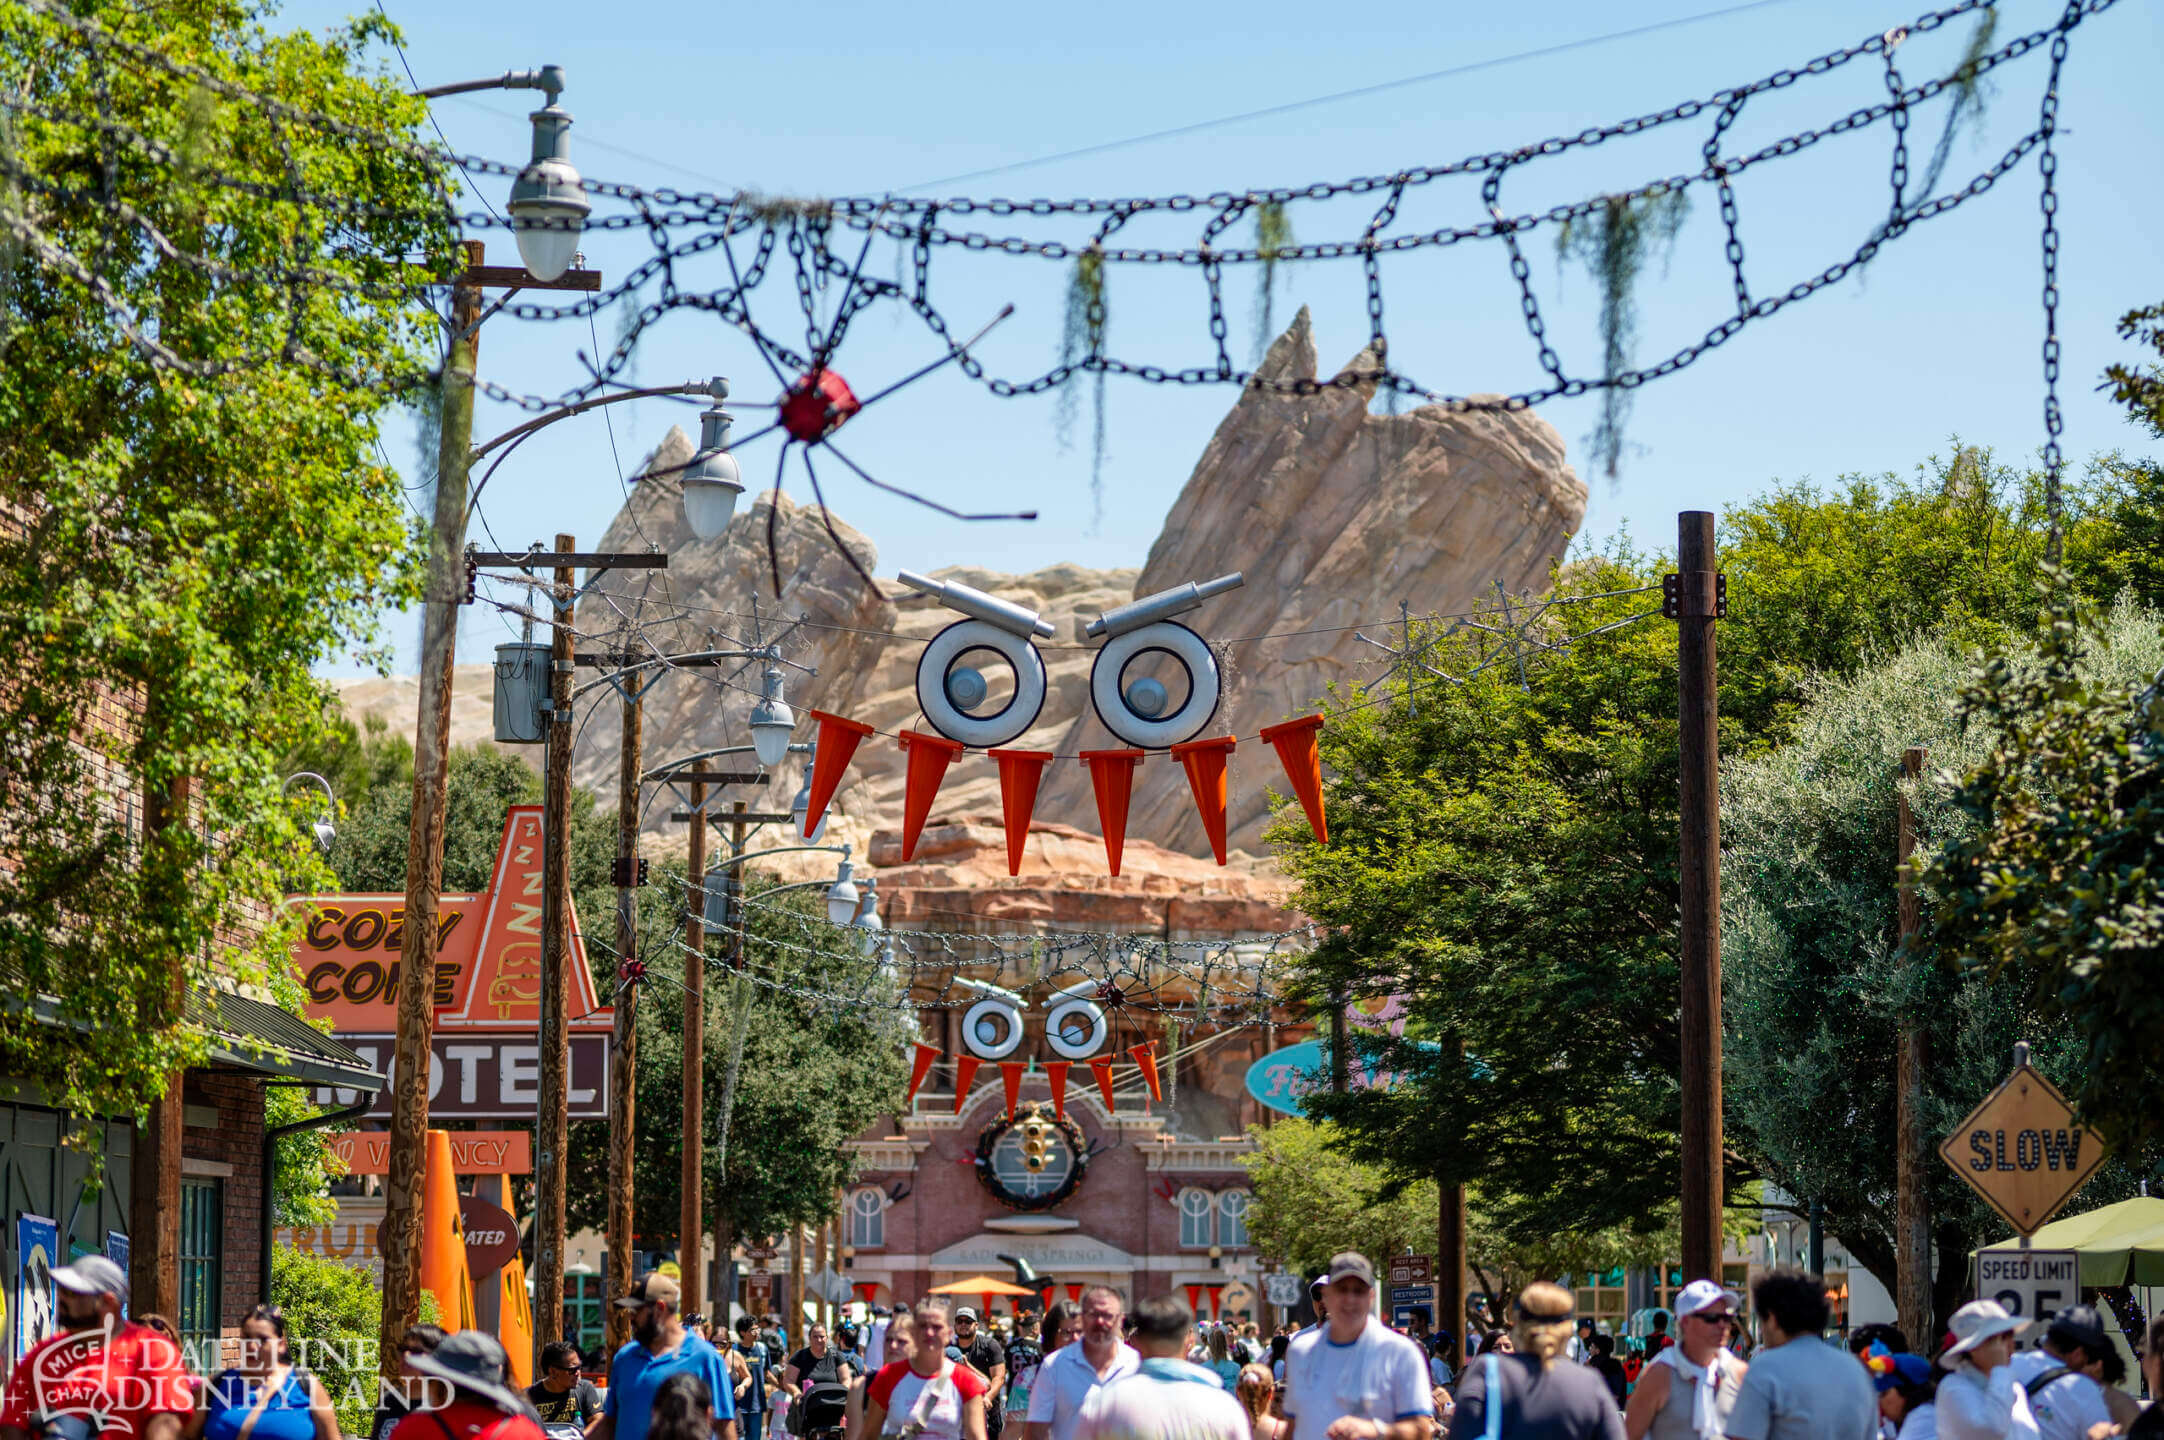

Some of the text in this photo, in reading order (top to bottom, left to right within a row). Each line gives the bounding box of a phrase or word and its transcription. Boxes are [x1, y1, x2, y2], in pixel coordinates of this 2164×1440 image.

[367, 1140, 510, 1167] VNCY
[1969, 1129, 2082, 1172] SLOW
[1982, 1261, 2073, 1280] SPEED LIMIT
